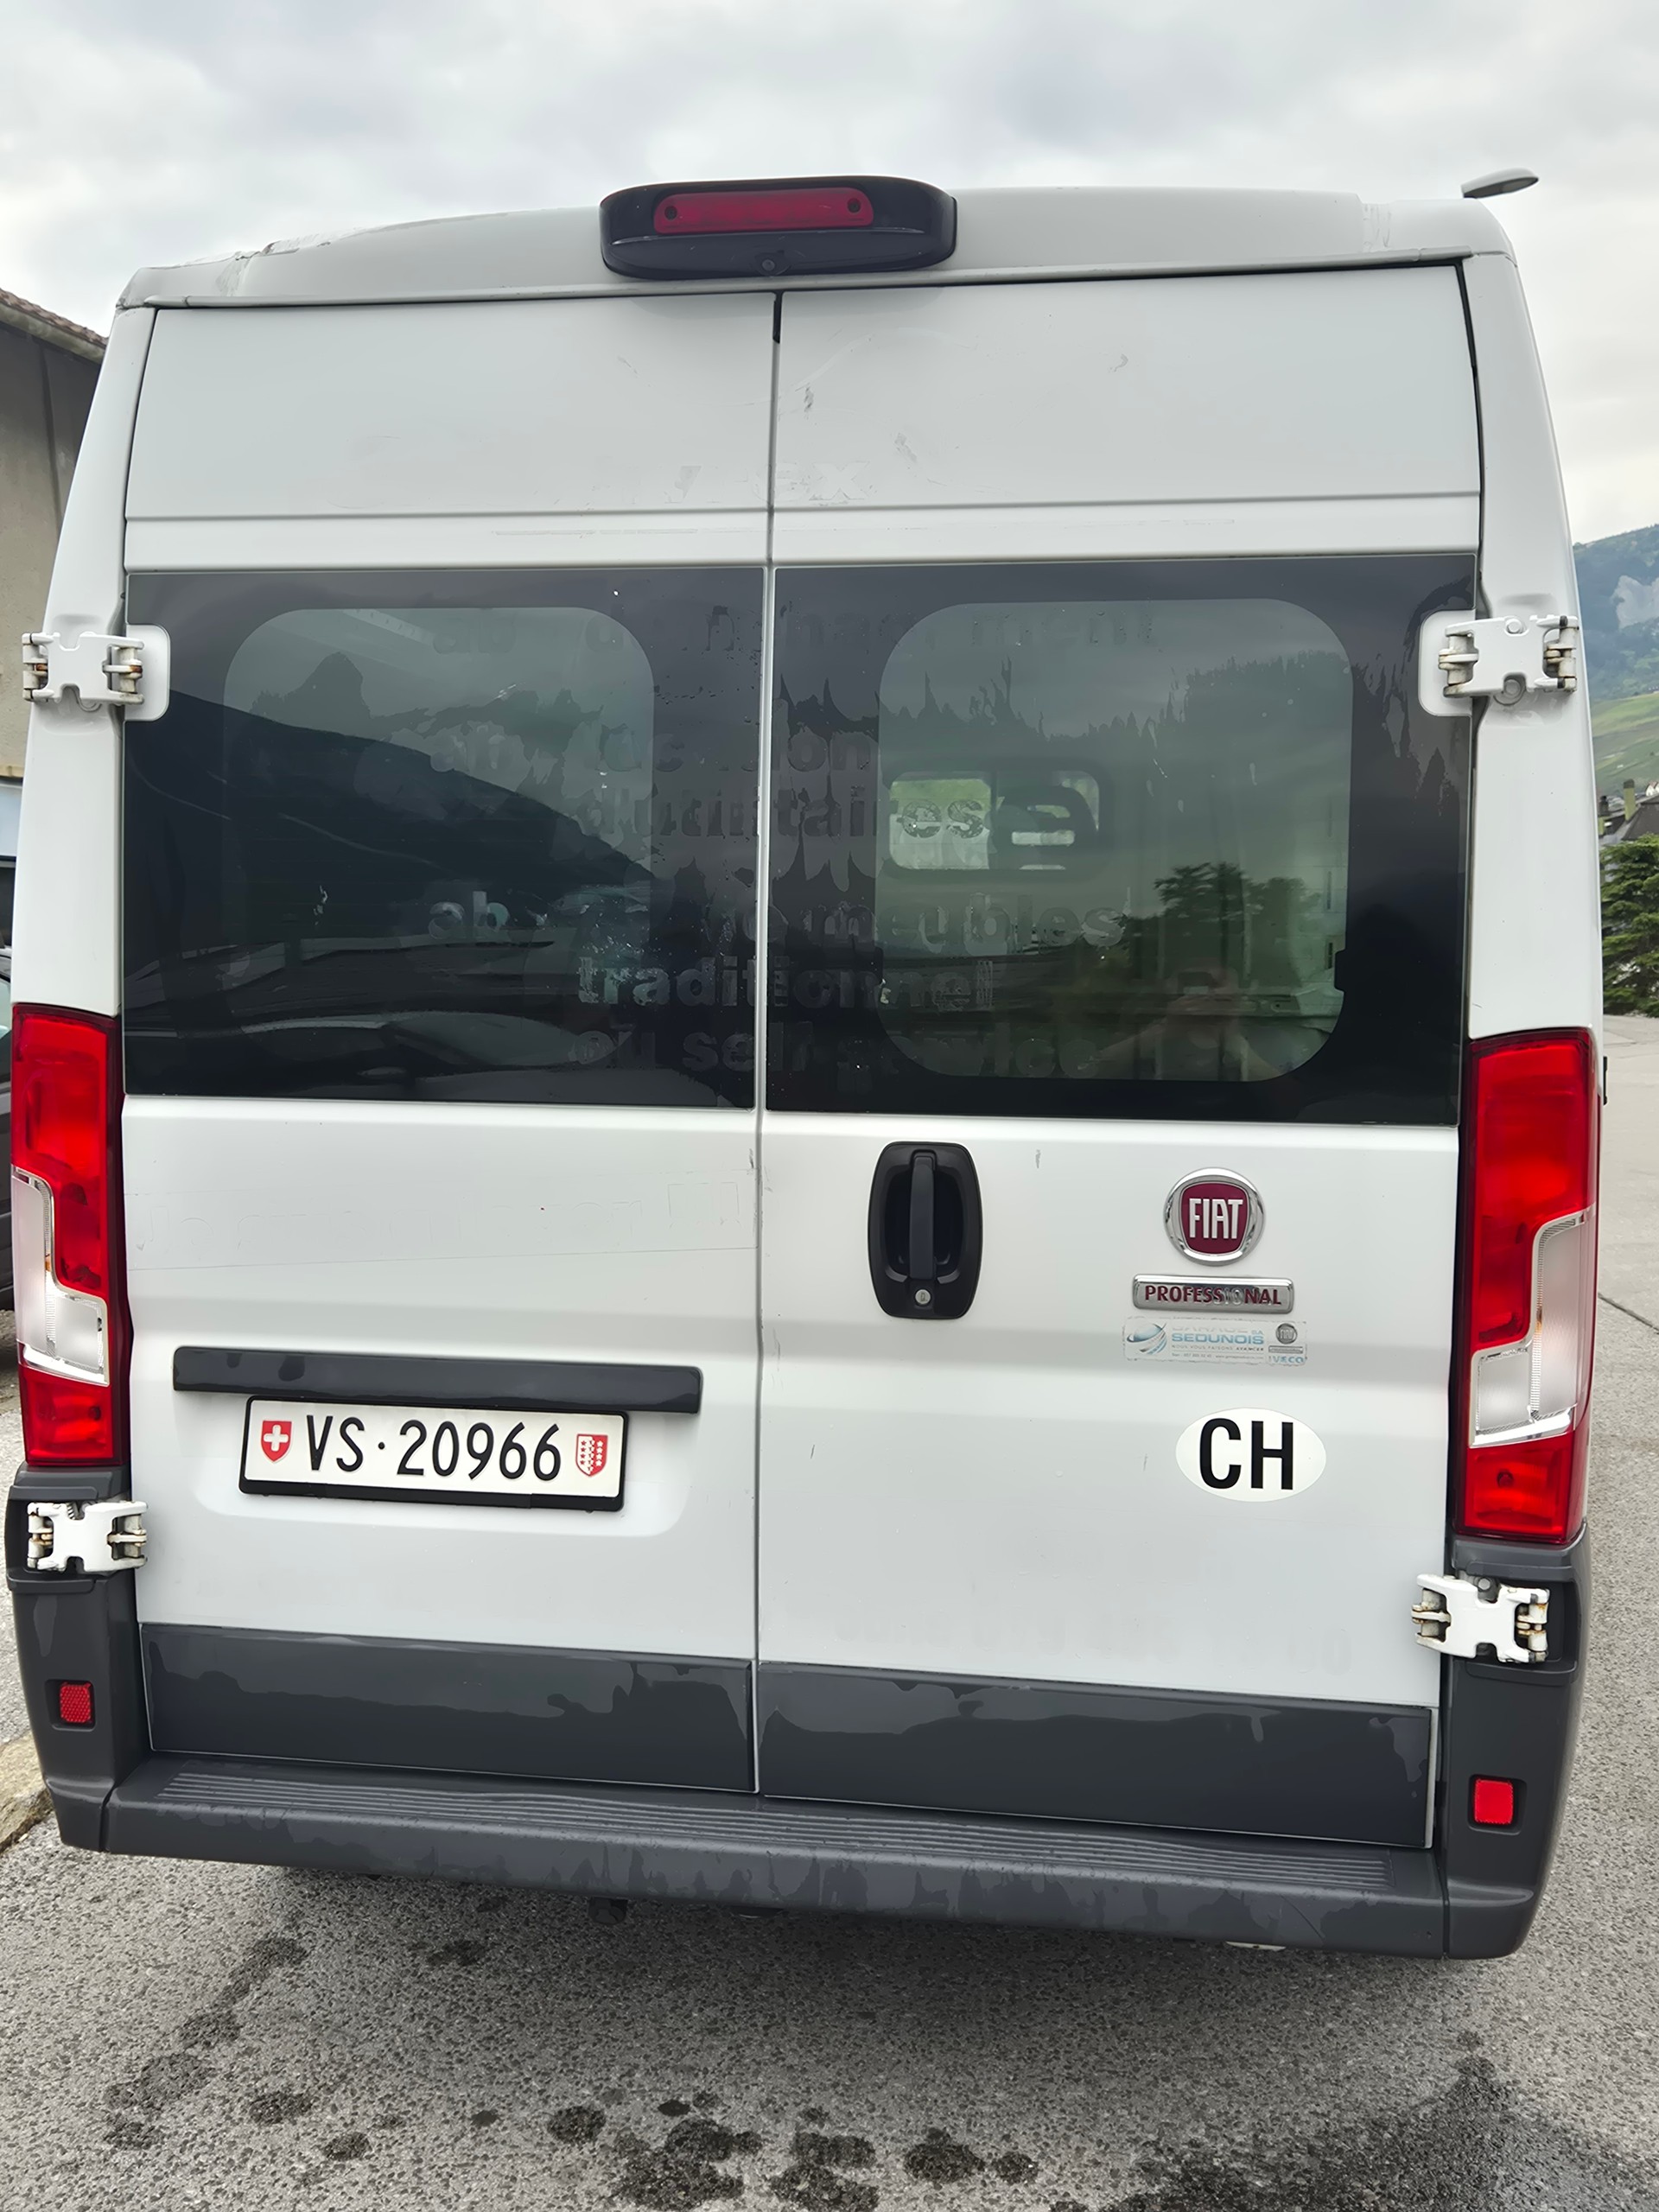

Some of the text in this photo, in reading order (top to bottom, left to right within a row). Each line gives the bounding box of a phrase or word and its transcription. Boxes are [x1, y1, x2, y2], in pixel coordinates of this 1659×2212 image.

[1189, 1198, 1244, 1239] FIAT
[1145, 1284, 1282, 1306] PROFESSIONAL
[1172, 1332, 1264, 1344] SEDUNOIS
[1199, 1418, 1294, 1490] CH
